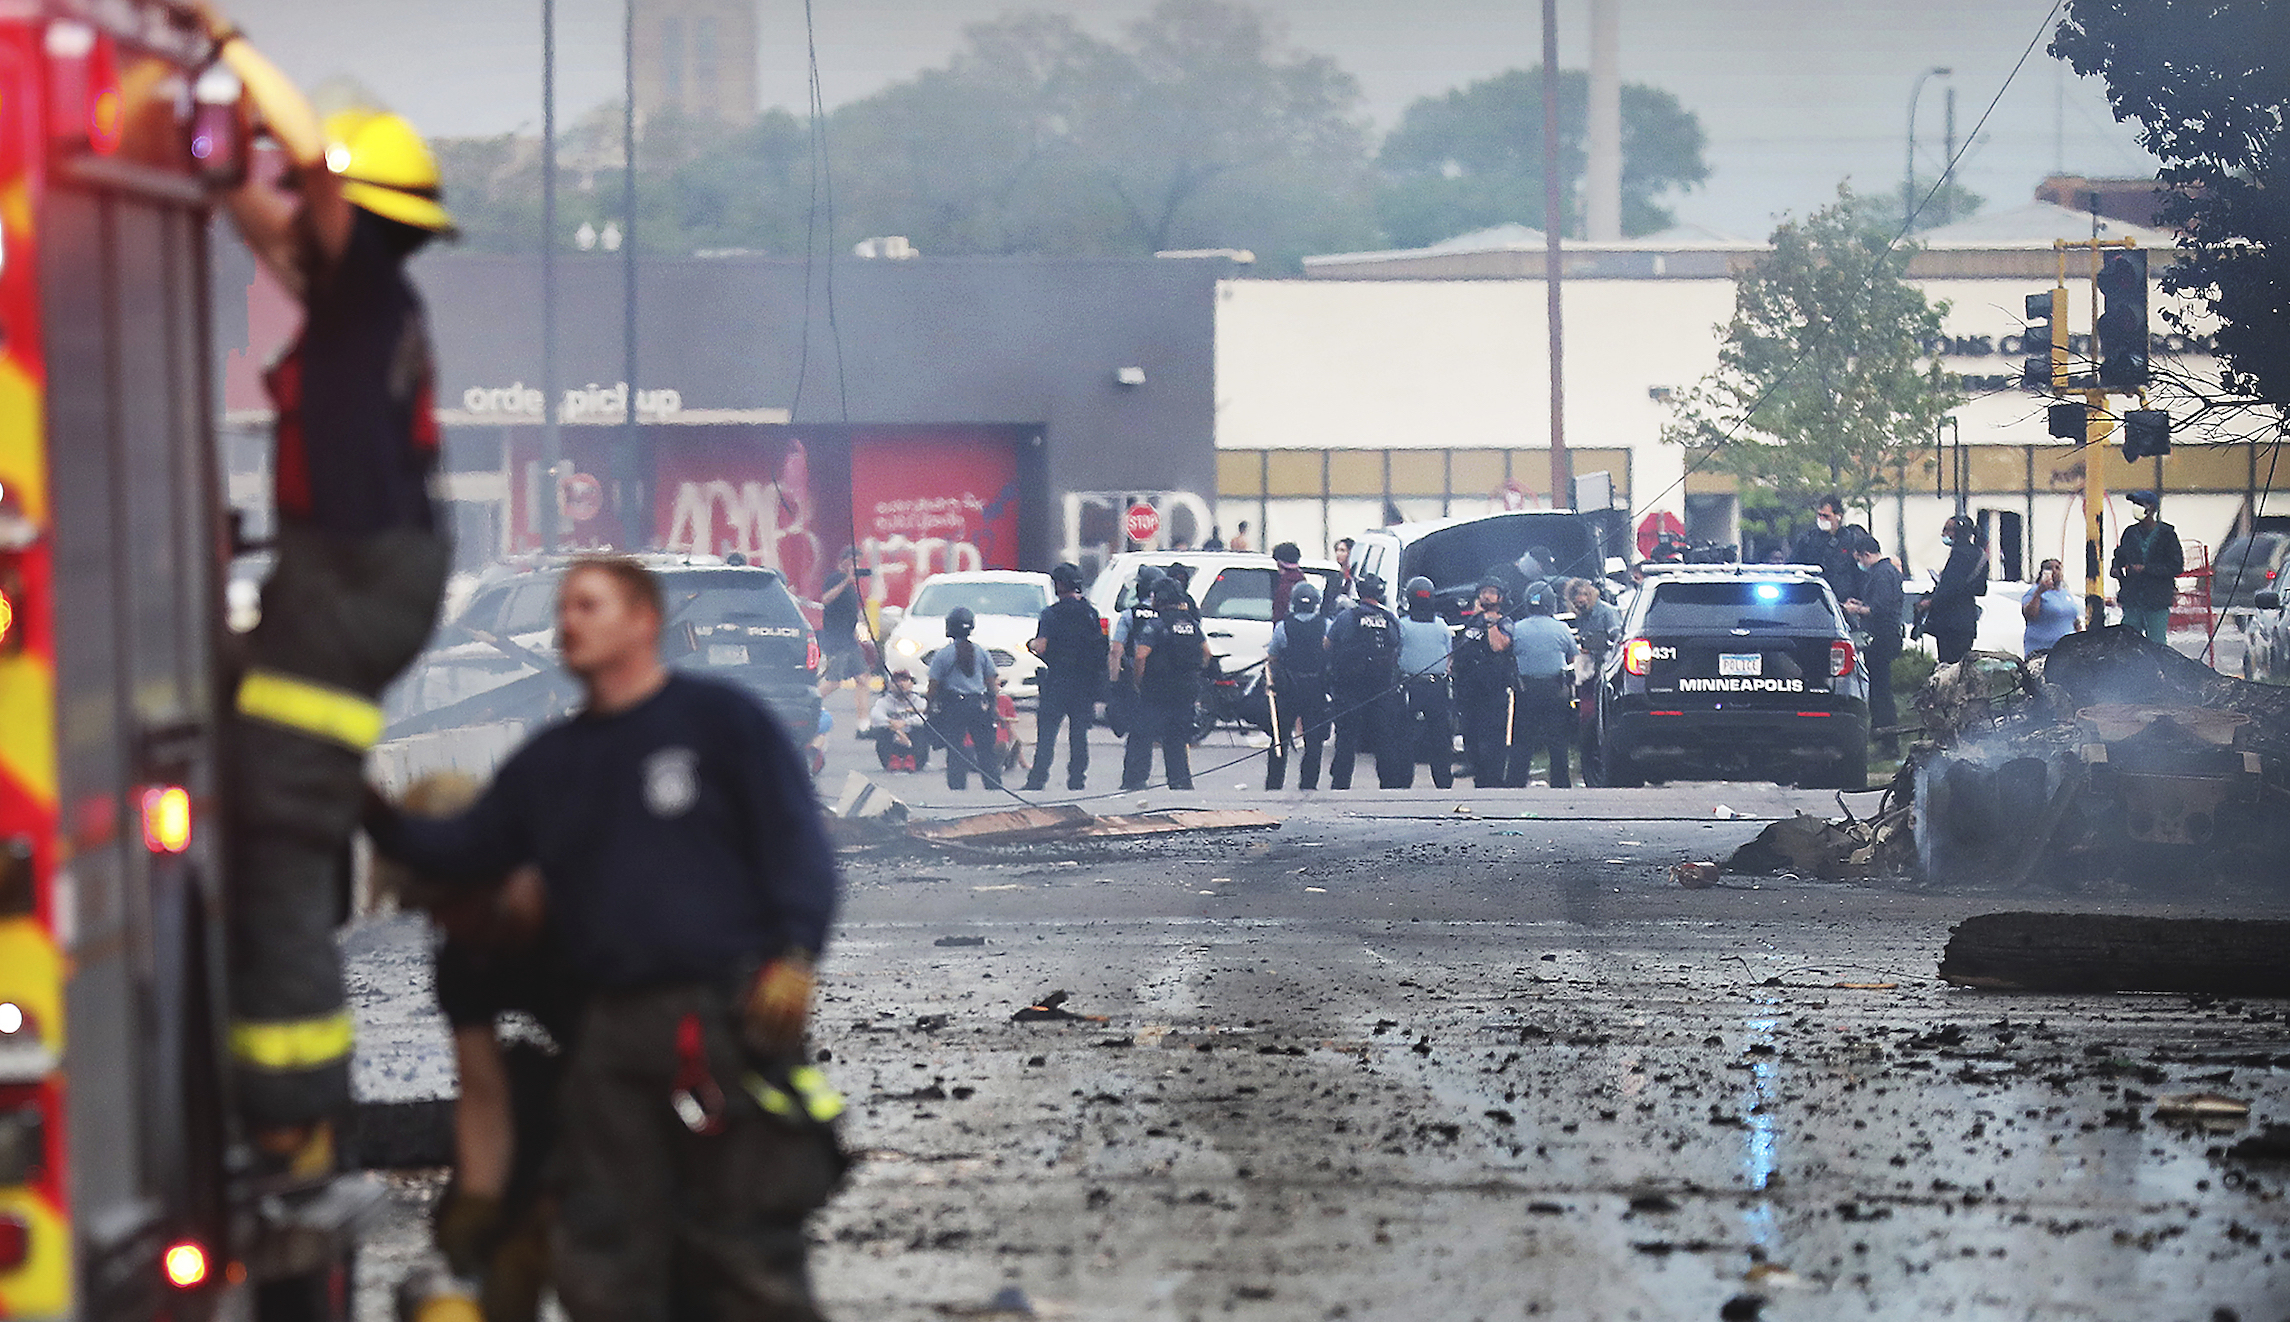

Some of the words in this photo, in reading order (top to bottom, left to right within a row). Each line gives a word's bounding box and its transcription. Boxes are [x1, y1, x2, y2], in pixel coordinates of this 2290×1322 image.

[464, 382, 546, 413] orde
[1129, 514, 1159, 530] STOP
[1360, 615, 1387, 629] POLICE
[747, 626, 800, 638] POLICE
[1651, 647, 1677, 660] 431
[1723, 660, 1758, 671] POLICE
[1679, 678, 1804, 693] MINNEAPOLIS
